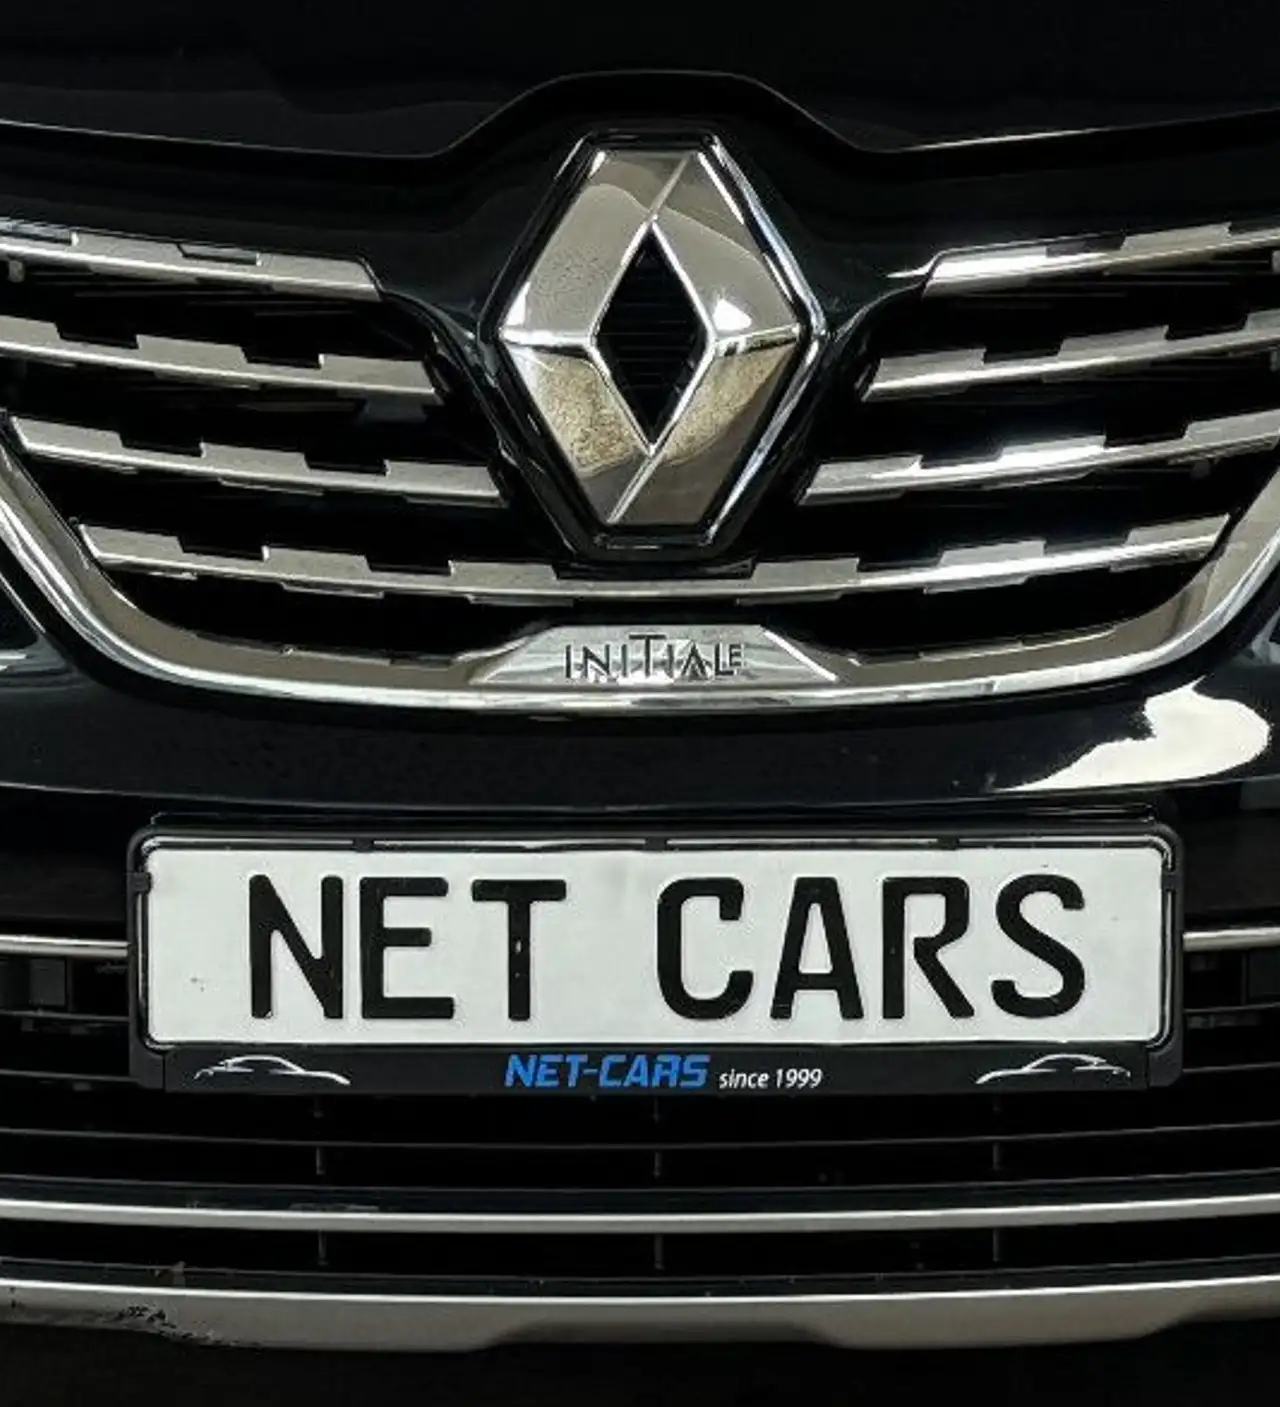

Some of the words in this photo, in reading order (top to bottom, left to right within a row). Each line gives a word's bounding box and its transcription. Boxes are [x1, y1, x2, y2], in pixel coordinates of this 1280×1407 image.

[565, 633, 742, 679] INITIALE
[248, 874, 568, 1022] NET
[656, 874, 1087, 1022] CARS
[504, 1054, 711, 1088] NET-CARS
[718, 1068, 770, 1089] since
[775, 1068, 823, 1089] 1999
